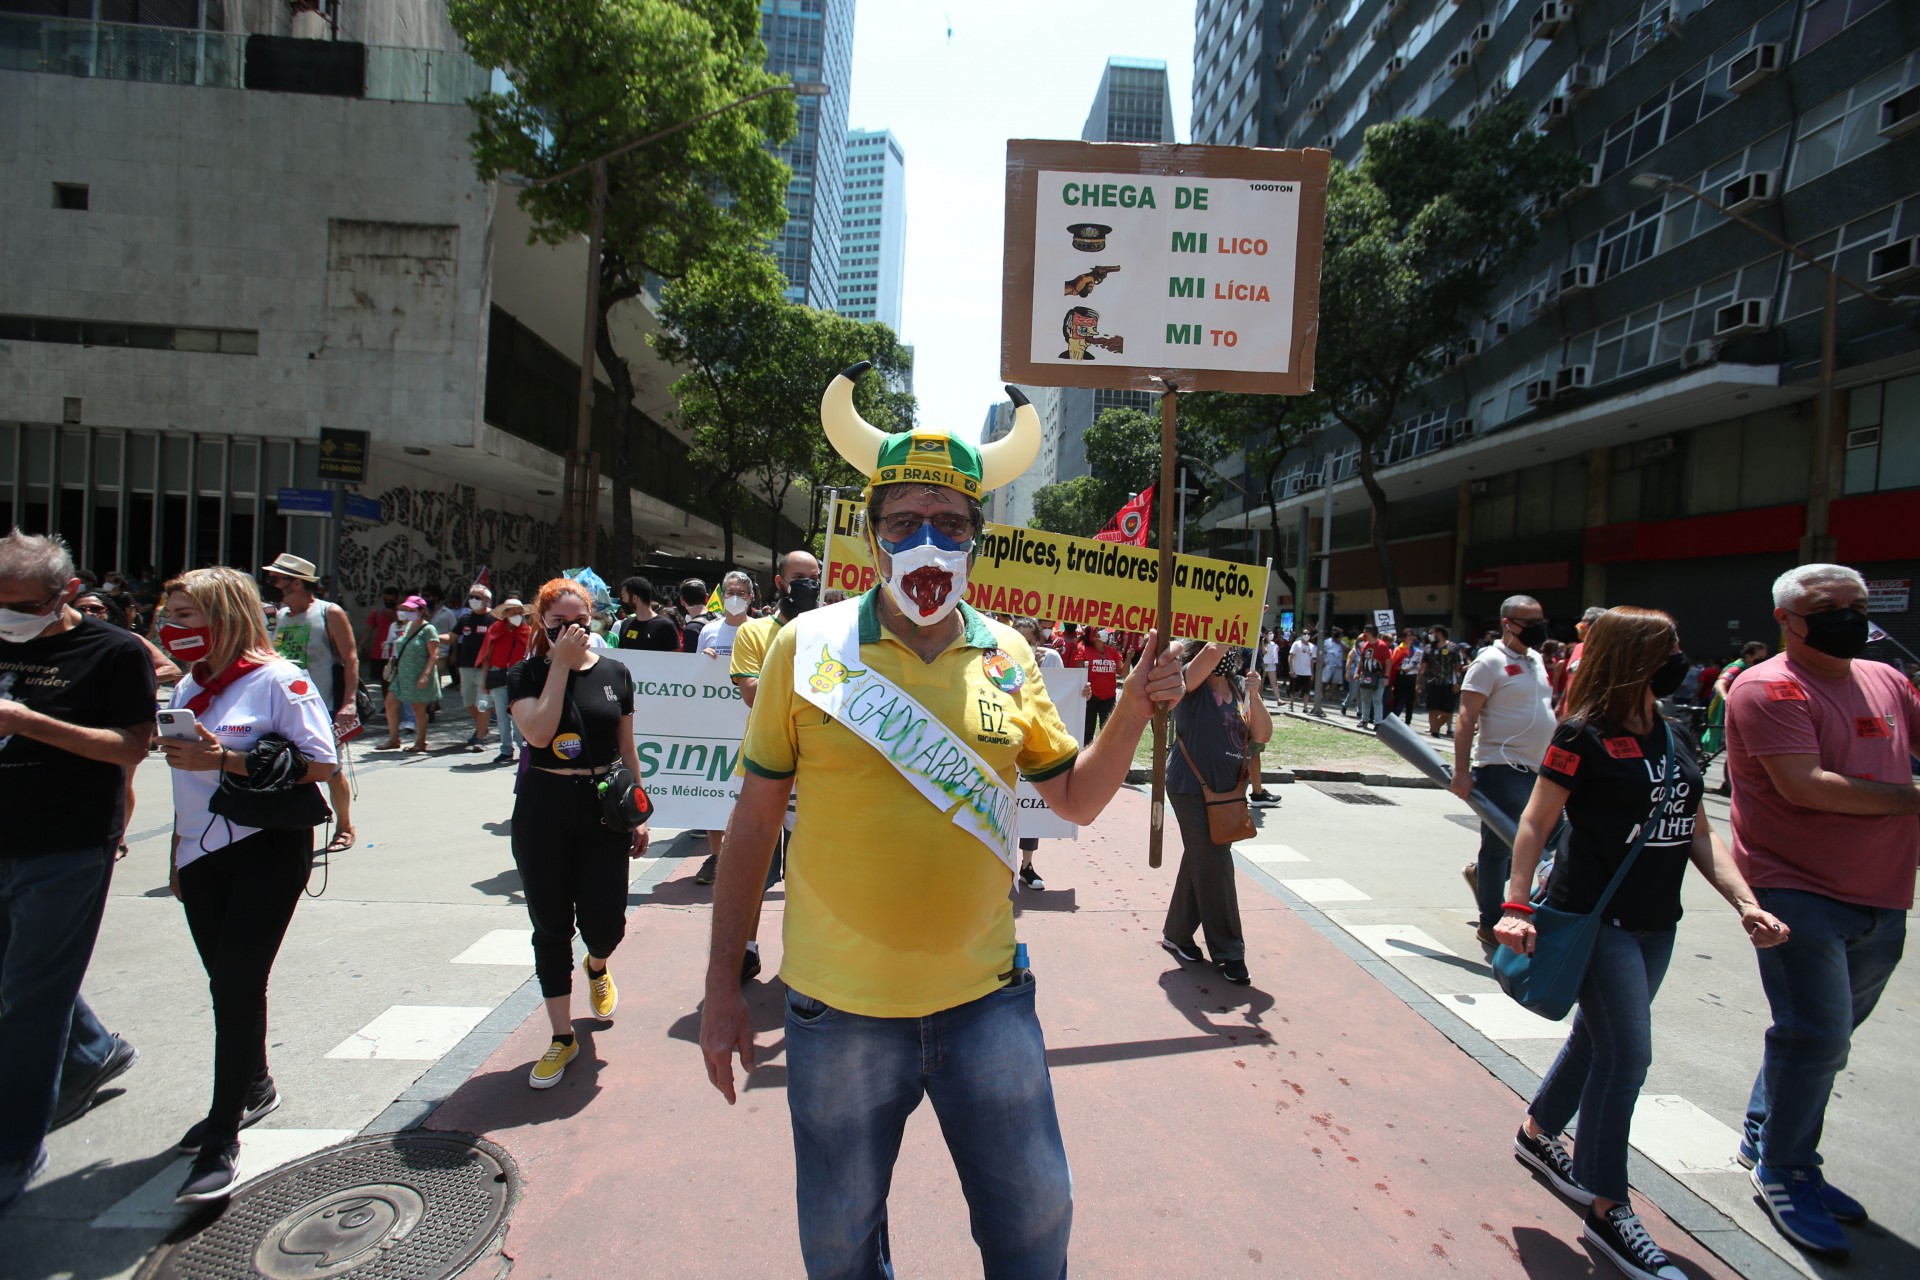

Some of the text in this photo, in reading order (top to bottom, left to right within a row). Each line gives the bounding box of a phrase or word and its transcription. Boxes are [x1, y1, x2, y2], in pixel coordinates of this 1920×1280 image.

[1062, 182, 1209, 211] CHEGA DE
[1249, 183, 1294, 194] 1000TON
[1171, 231, 1268, 256] MI LICO
[1168, 276, 1270, 302] MI LÍCIA
[1165, 323, 1239, 348] MI TO
[903, 468, 958, 487] BRASIL
[1067, 540, 1160, 583] traidores
[1190, 564, 1254, 603] nação.
[1868, 580, 1904, 588] ALUGO
[828, 562, 876, 593] FOR
[966, 580, 1042, 617] ONARO
[1057, 595, 1214, 641] IMPEACHENT
[1215, 614, 1249, 646] JÁ!
[0, 661, 60, 674] universe
[25, 675, 71, 688] under
[702, 685, 742, 700] DOS
[848, 684, 928, 760] GADO
[978, 699, 1008, 736] 62
[215, 725, 252, 733] ABMMD
[672, 785, 725, 799] Médicos
